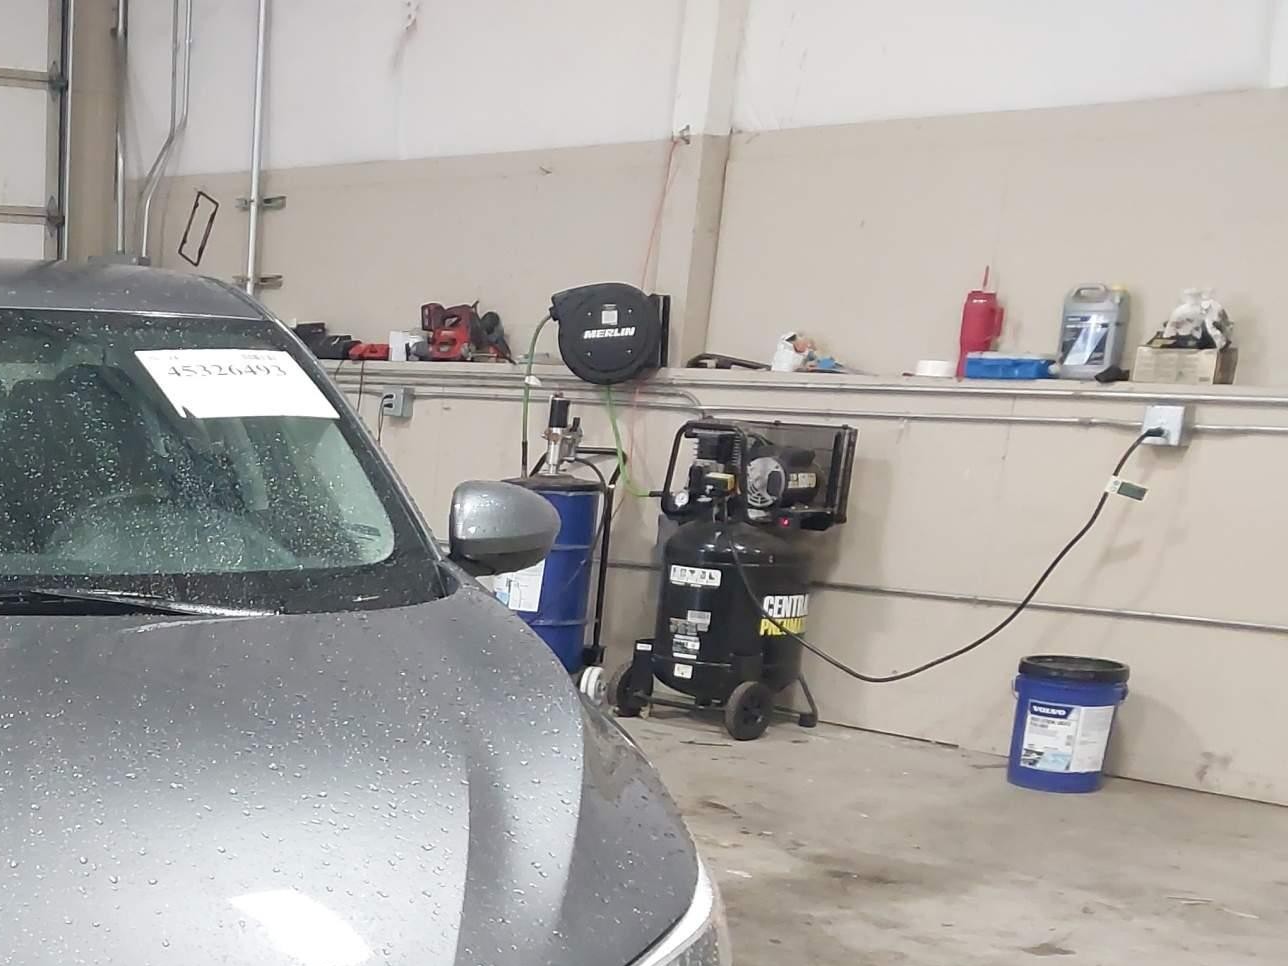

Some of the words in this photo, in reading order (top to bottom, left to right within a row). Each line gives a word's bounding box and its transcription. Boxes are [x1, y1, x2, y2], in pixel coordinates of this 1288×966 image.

[583, 326, 636, 339] MERLIN
[167, 364, 288, 377] 45326493
[1032, 705, 1067, 716] VOLVO
